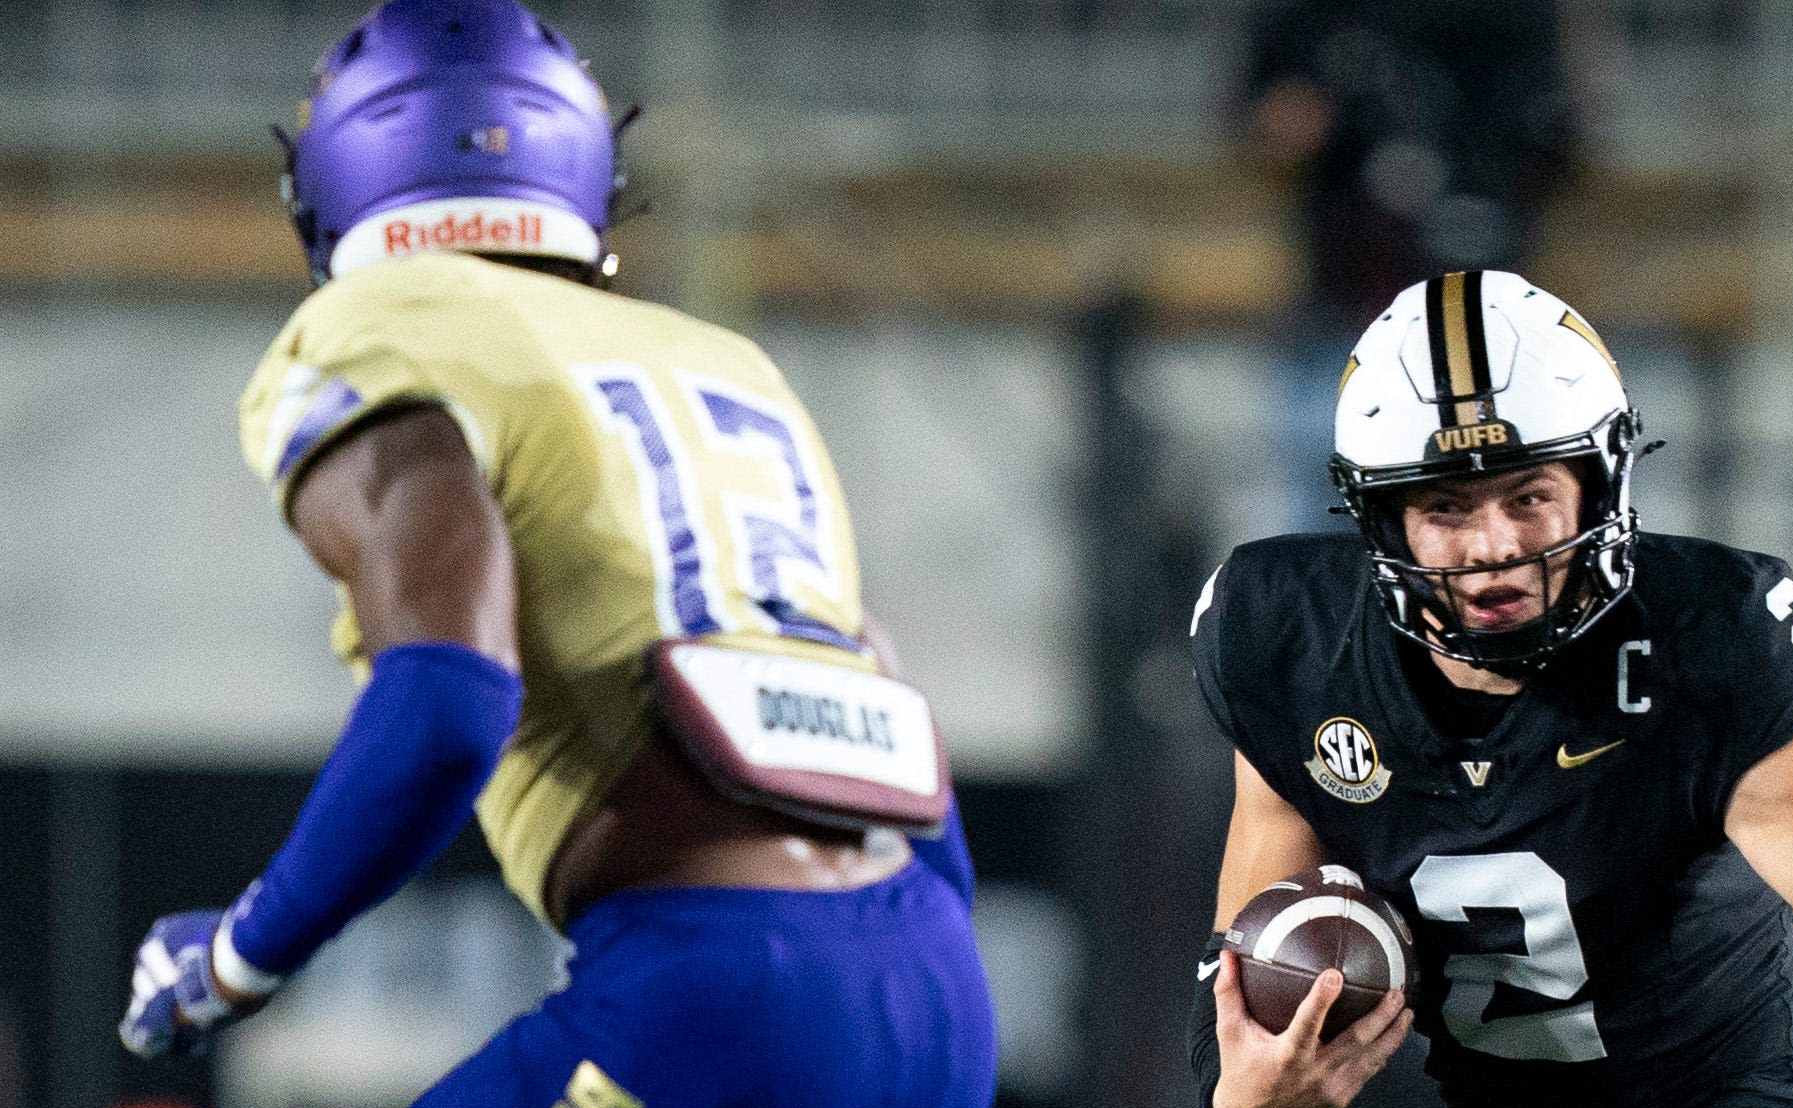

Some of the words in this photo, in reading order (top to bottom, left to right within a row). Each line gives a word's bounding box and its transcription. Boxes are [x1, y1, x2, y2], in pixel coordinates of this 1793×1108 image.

[384, 211, 543, 254] Riddell
[1435, 423, 1508, 453] VUFB
[580, 362, 872, 656] 12
[1617, 640, 1651, 714] C
[757, 685, 893, 751] DOUGLAS
[1320, 723, 1372, 781] SEC
[1461, 761, 1488, 787] V
[1319, 773, 1382, 800] GRADUATE
[1410, 853, 1607, 1061] 2
